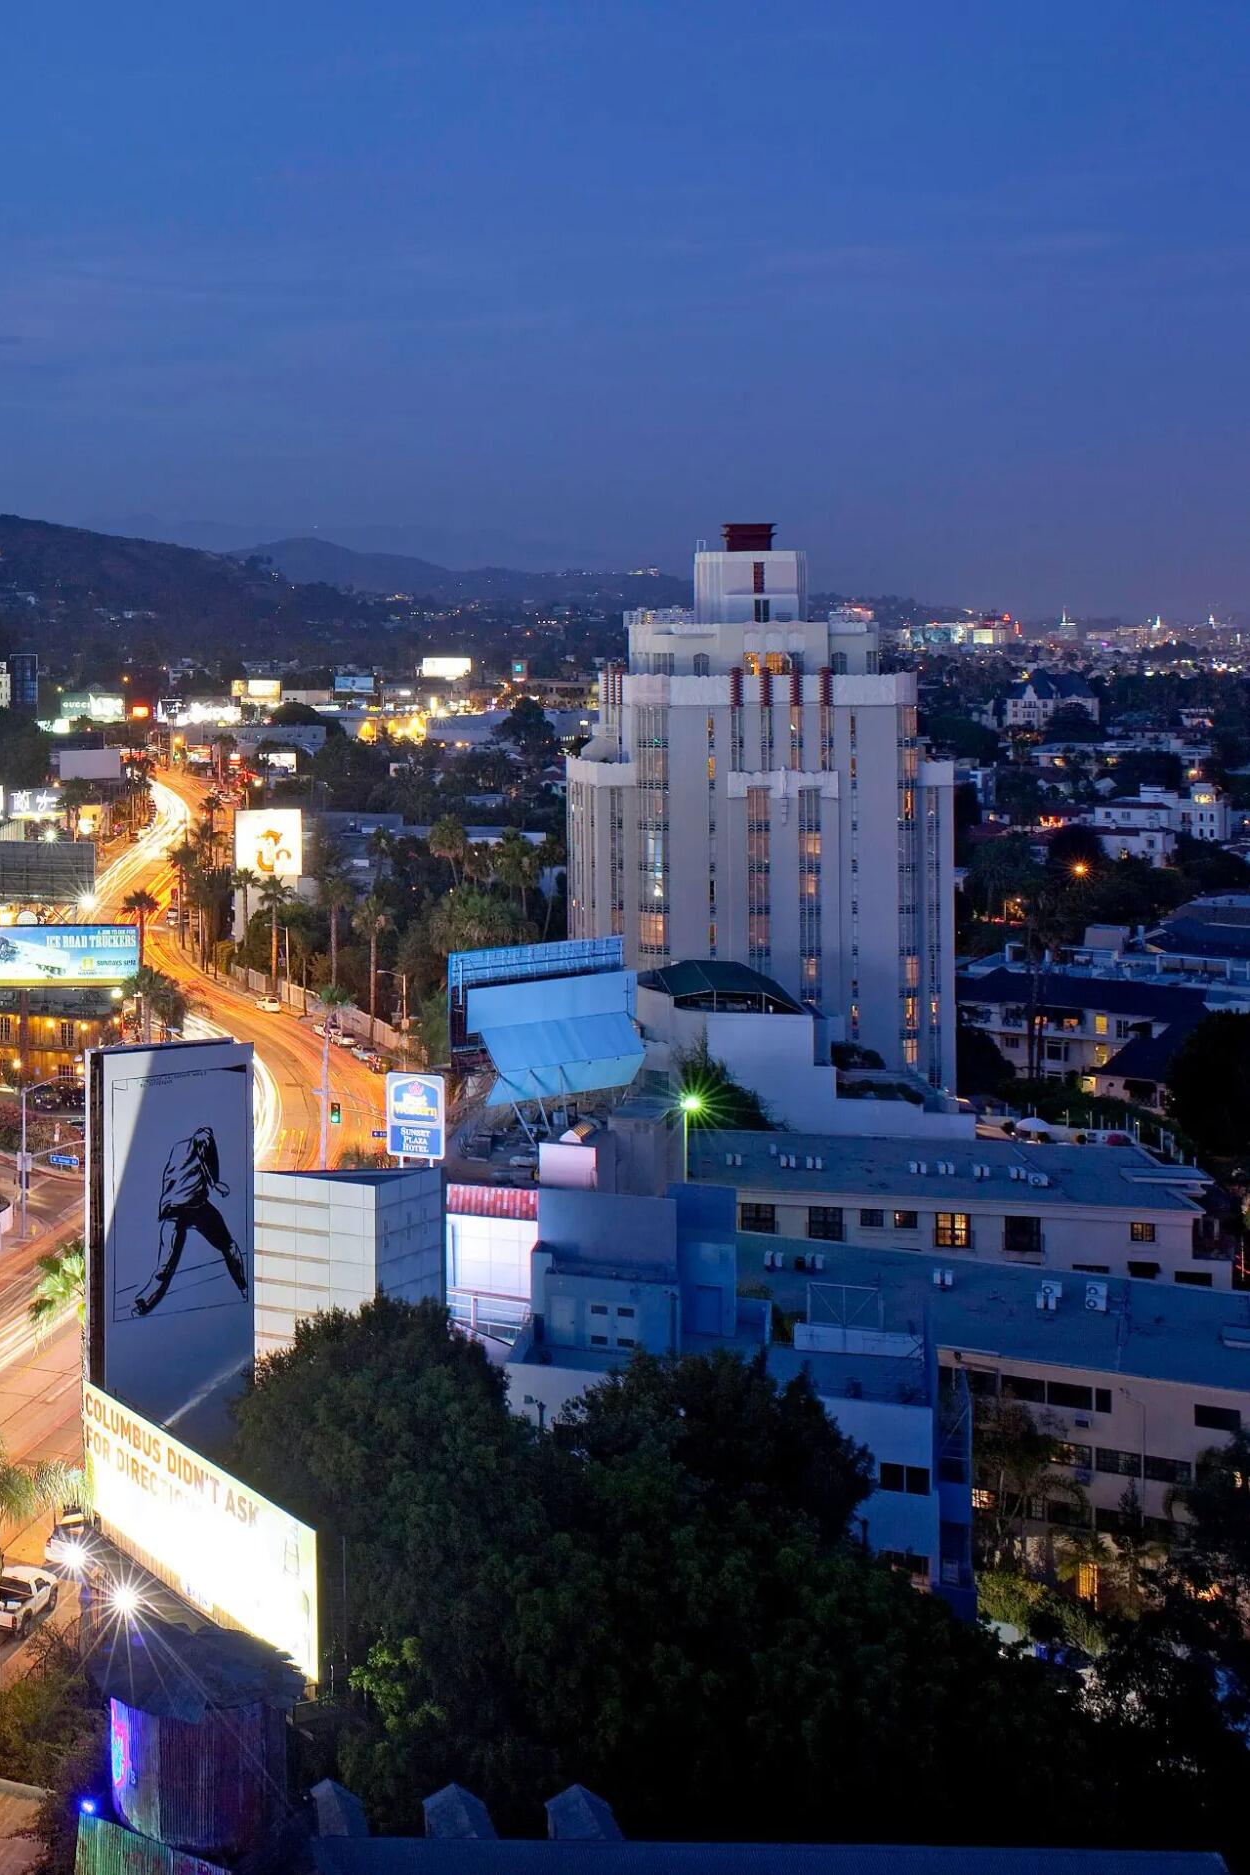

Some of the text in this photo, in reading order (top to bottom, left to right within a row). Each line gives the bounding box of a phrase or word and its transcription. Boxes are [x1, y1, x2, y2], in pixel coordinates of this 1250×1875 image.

[46, 934, 137, 948] ICE ROAD TRUCKERS
[400, 1127, 431, 1138] SUNSET
[403, 1135, 428, 1145] PLAZA
[402, 1143, 429, 1153] HOTEL
[86, 1424, 111, 1462] FOR
[85, 1392, 259, 1527] COLUMBUS DIDN'T ASK
